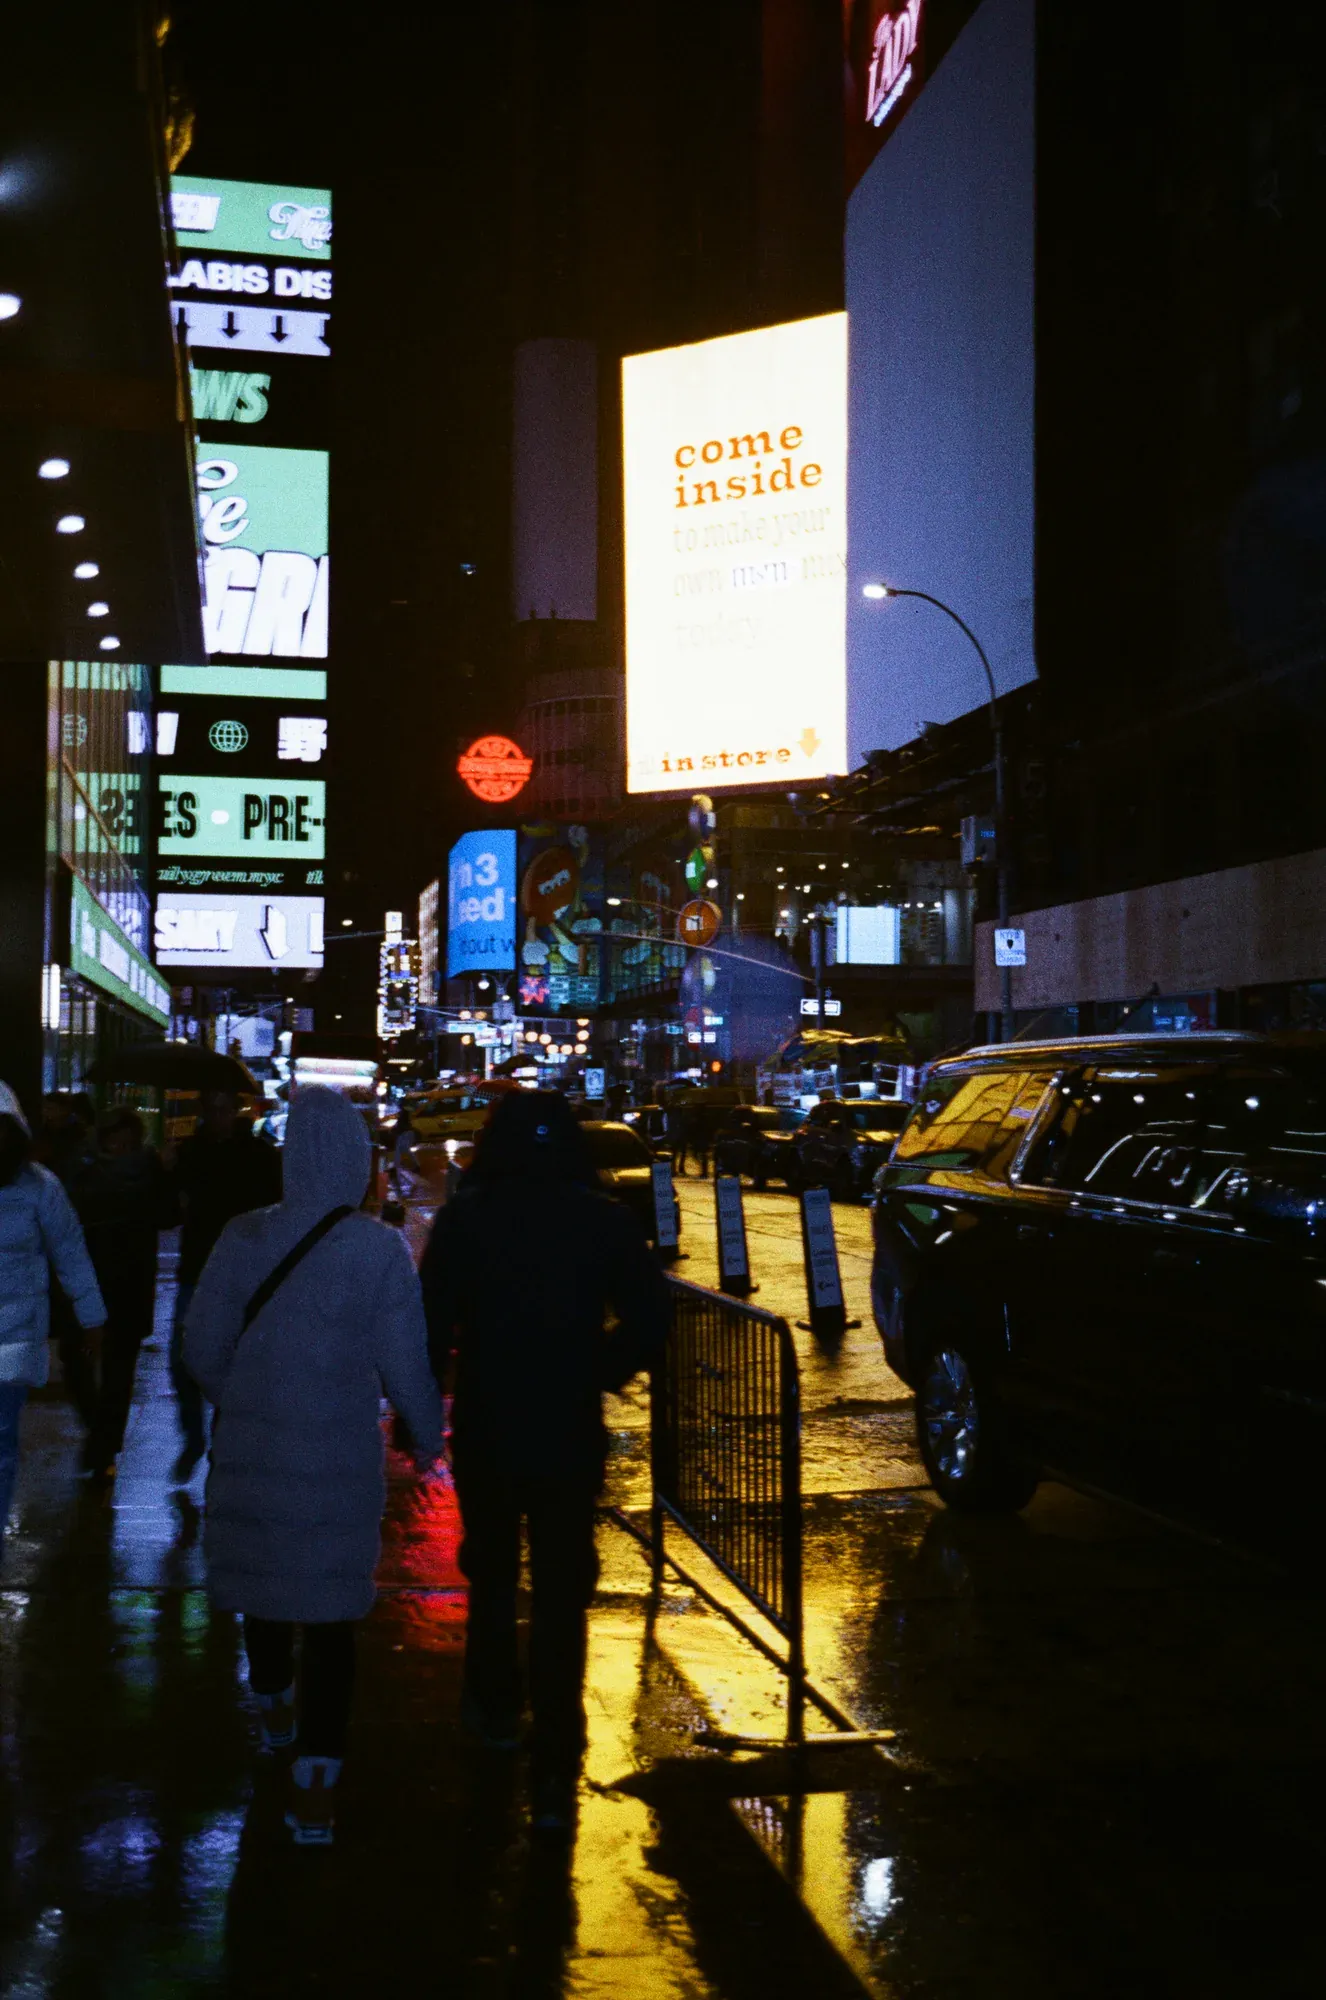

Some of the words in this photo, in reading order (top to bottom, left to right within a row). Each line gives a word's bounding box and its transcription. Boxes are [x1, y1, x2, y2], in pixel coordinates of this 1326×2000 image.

[674, 423, 804, 470] come
[673, 458, 823, 510] inside
[659, 751, 695, 773] in
[700, 747, 793, 770] store
